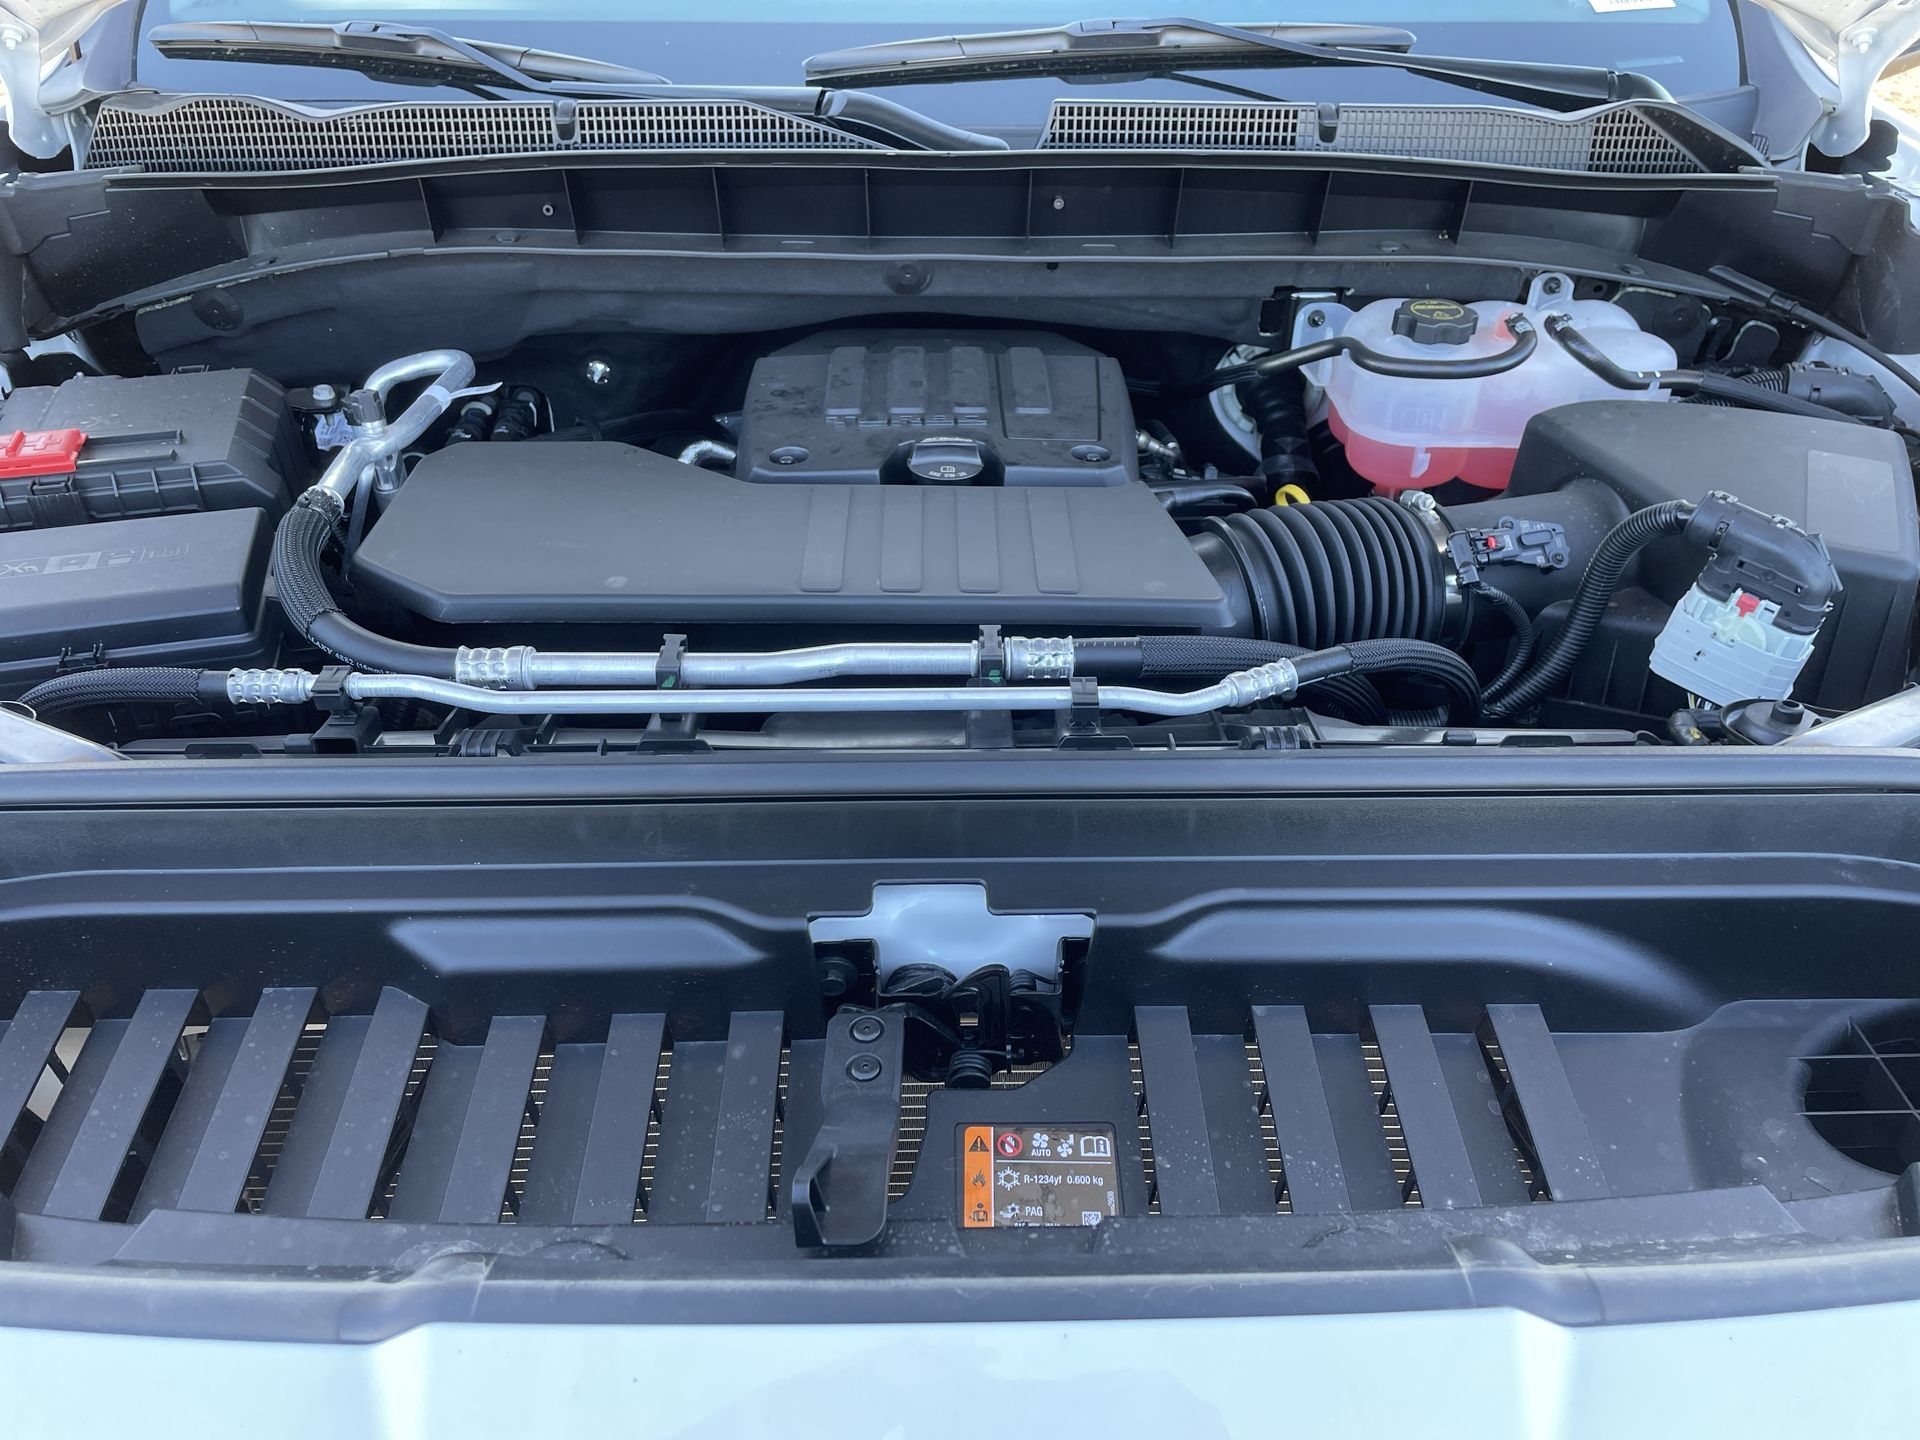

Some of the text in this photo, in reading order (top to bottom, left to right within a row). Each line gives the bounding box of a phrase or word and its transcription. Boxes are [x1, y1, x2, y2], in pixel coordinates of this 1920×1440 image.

[1031, 1148, 1051, 1157] AUTO
[1023, 1174, 1104, 1187] R-1234yf 0.600 kg
[1025, 1206, 1044, 1217] PAG
